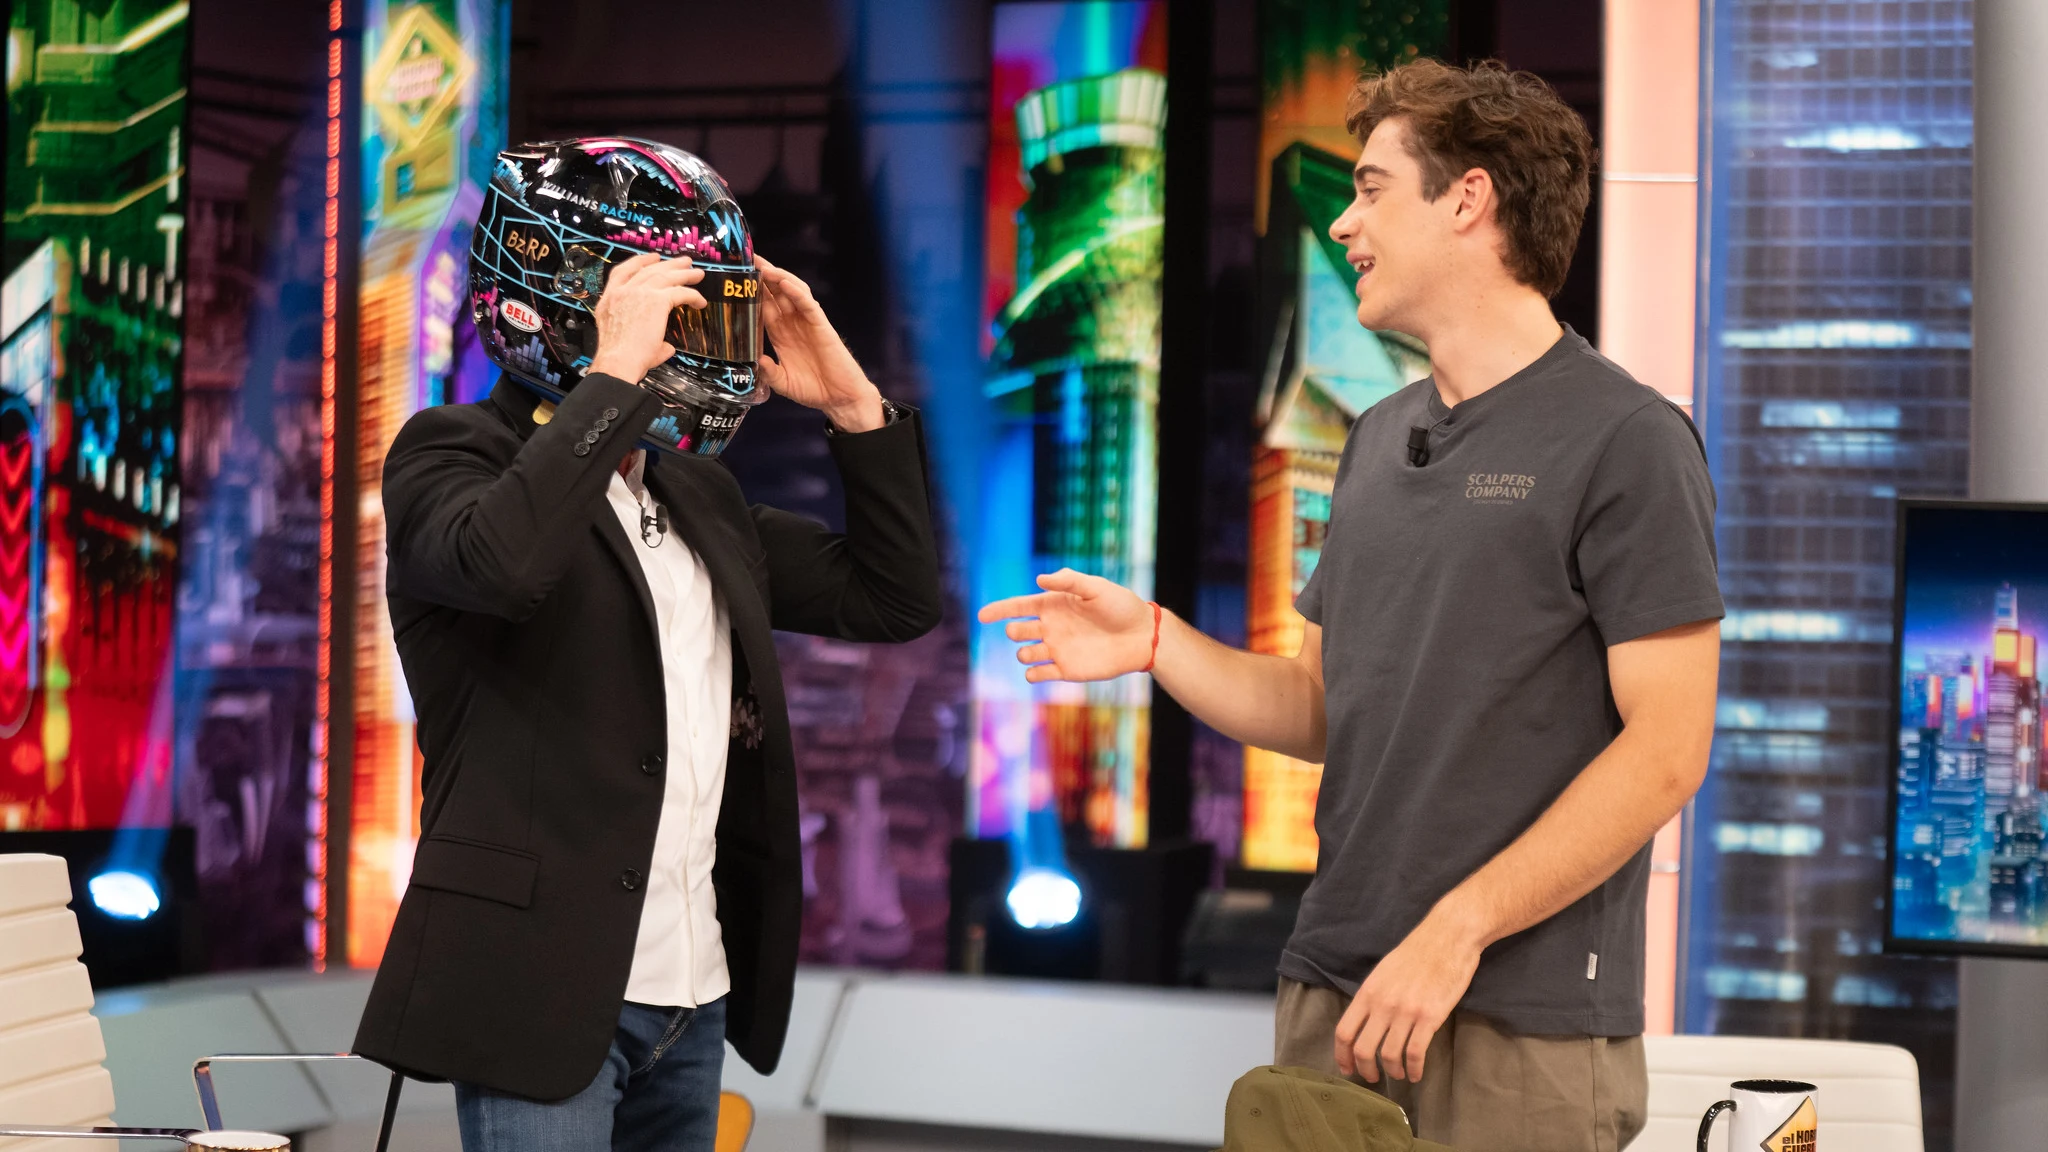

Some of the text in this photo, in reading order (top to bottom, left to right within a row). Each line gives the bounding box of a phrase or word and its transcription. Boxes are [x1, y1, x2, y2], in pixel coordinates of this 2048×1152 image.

[541, 180, 655, 226] WILLIAMS RACING
[505, 303, 535, 327] BELL
[732, 374, 751, 384] YPF
[1467, 473, 1537, 488] SCALPERS
[1465, 485, 1531, 500] COMPANY
[1796, 1129, 1817, 1144] HOR
